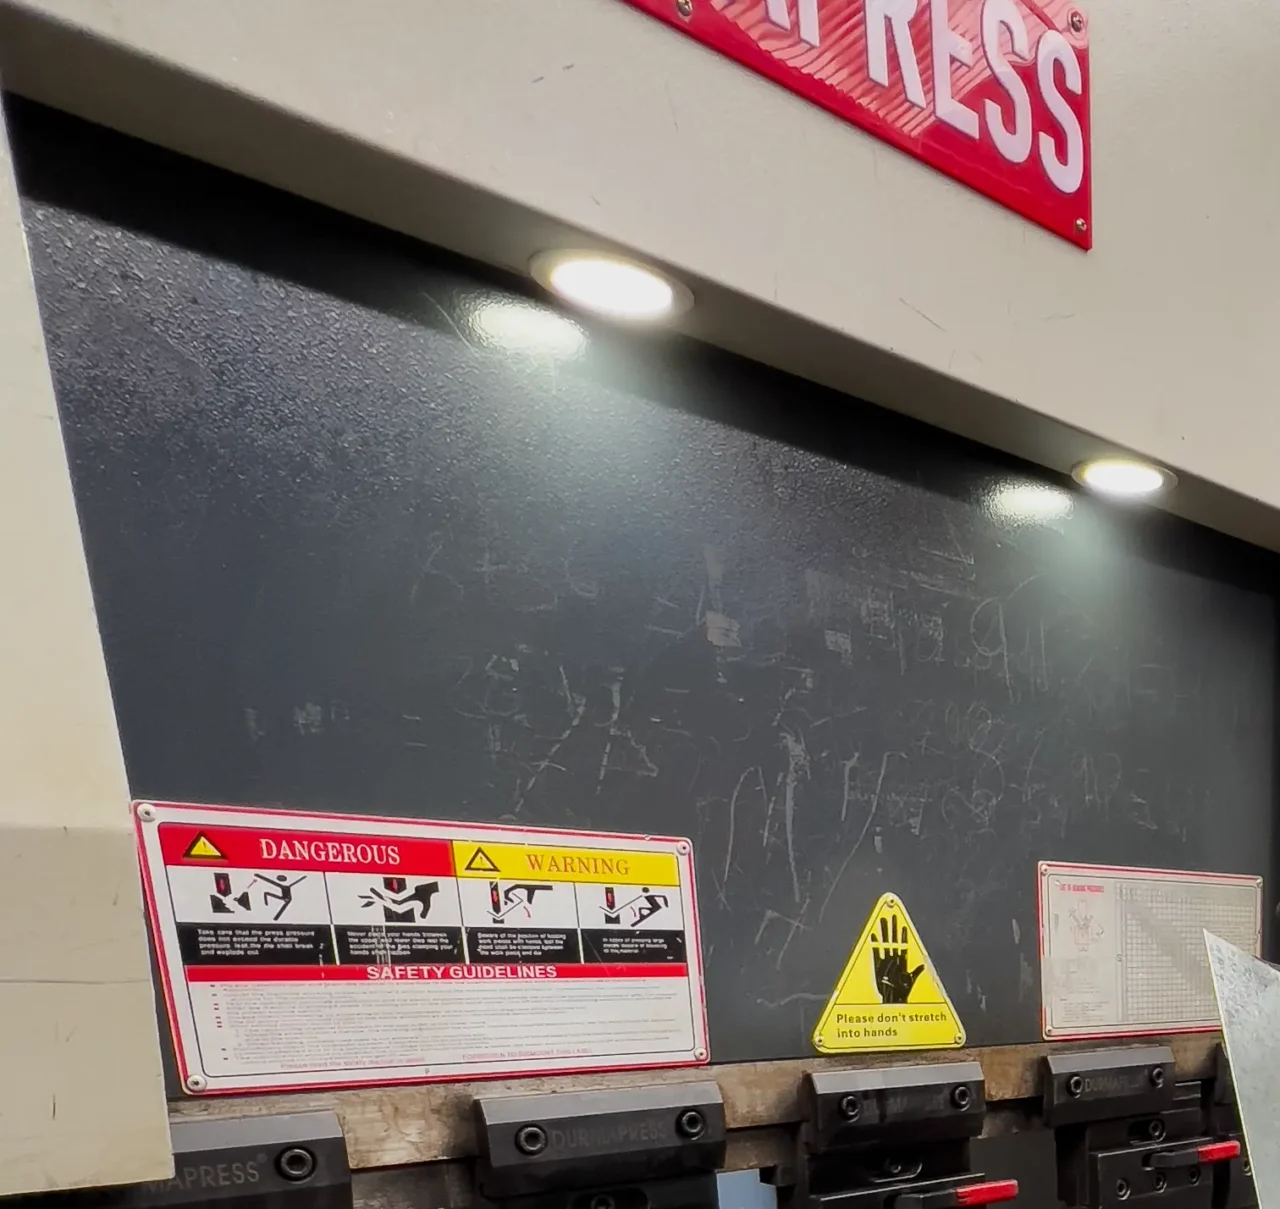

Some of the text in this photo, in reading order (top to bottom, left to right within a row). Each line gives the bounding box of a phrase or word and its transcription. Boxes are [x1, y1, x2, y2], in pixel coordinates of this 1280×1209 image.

[260, 839, 400, 865] DANGEROUS
[526, 854, 630, 876] WARNING
[366, 965, 557, 979] SAFETY GUIDELINES
[836, 1013, 875, 1024] Please
[877, 1012, 906, 1023] don't
[837, 1027, 898, 1039] into hands
